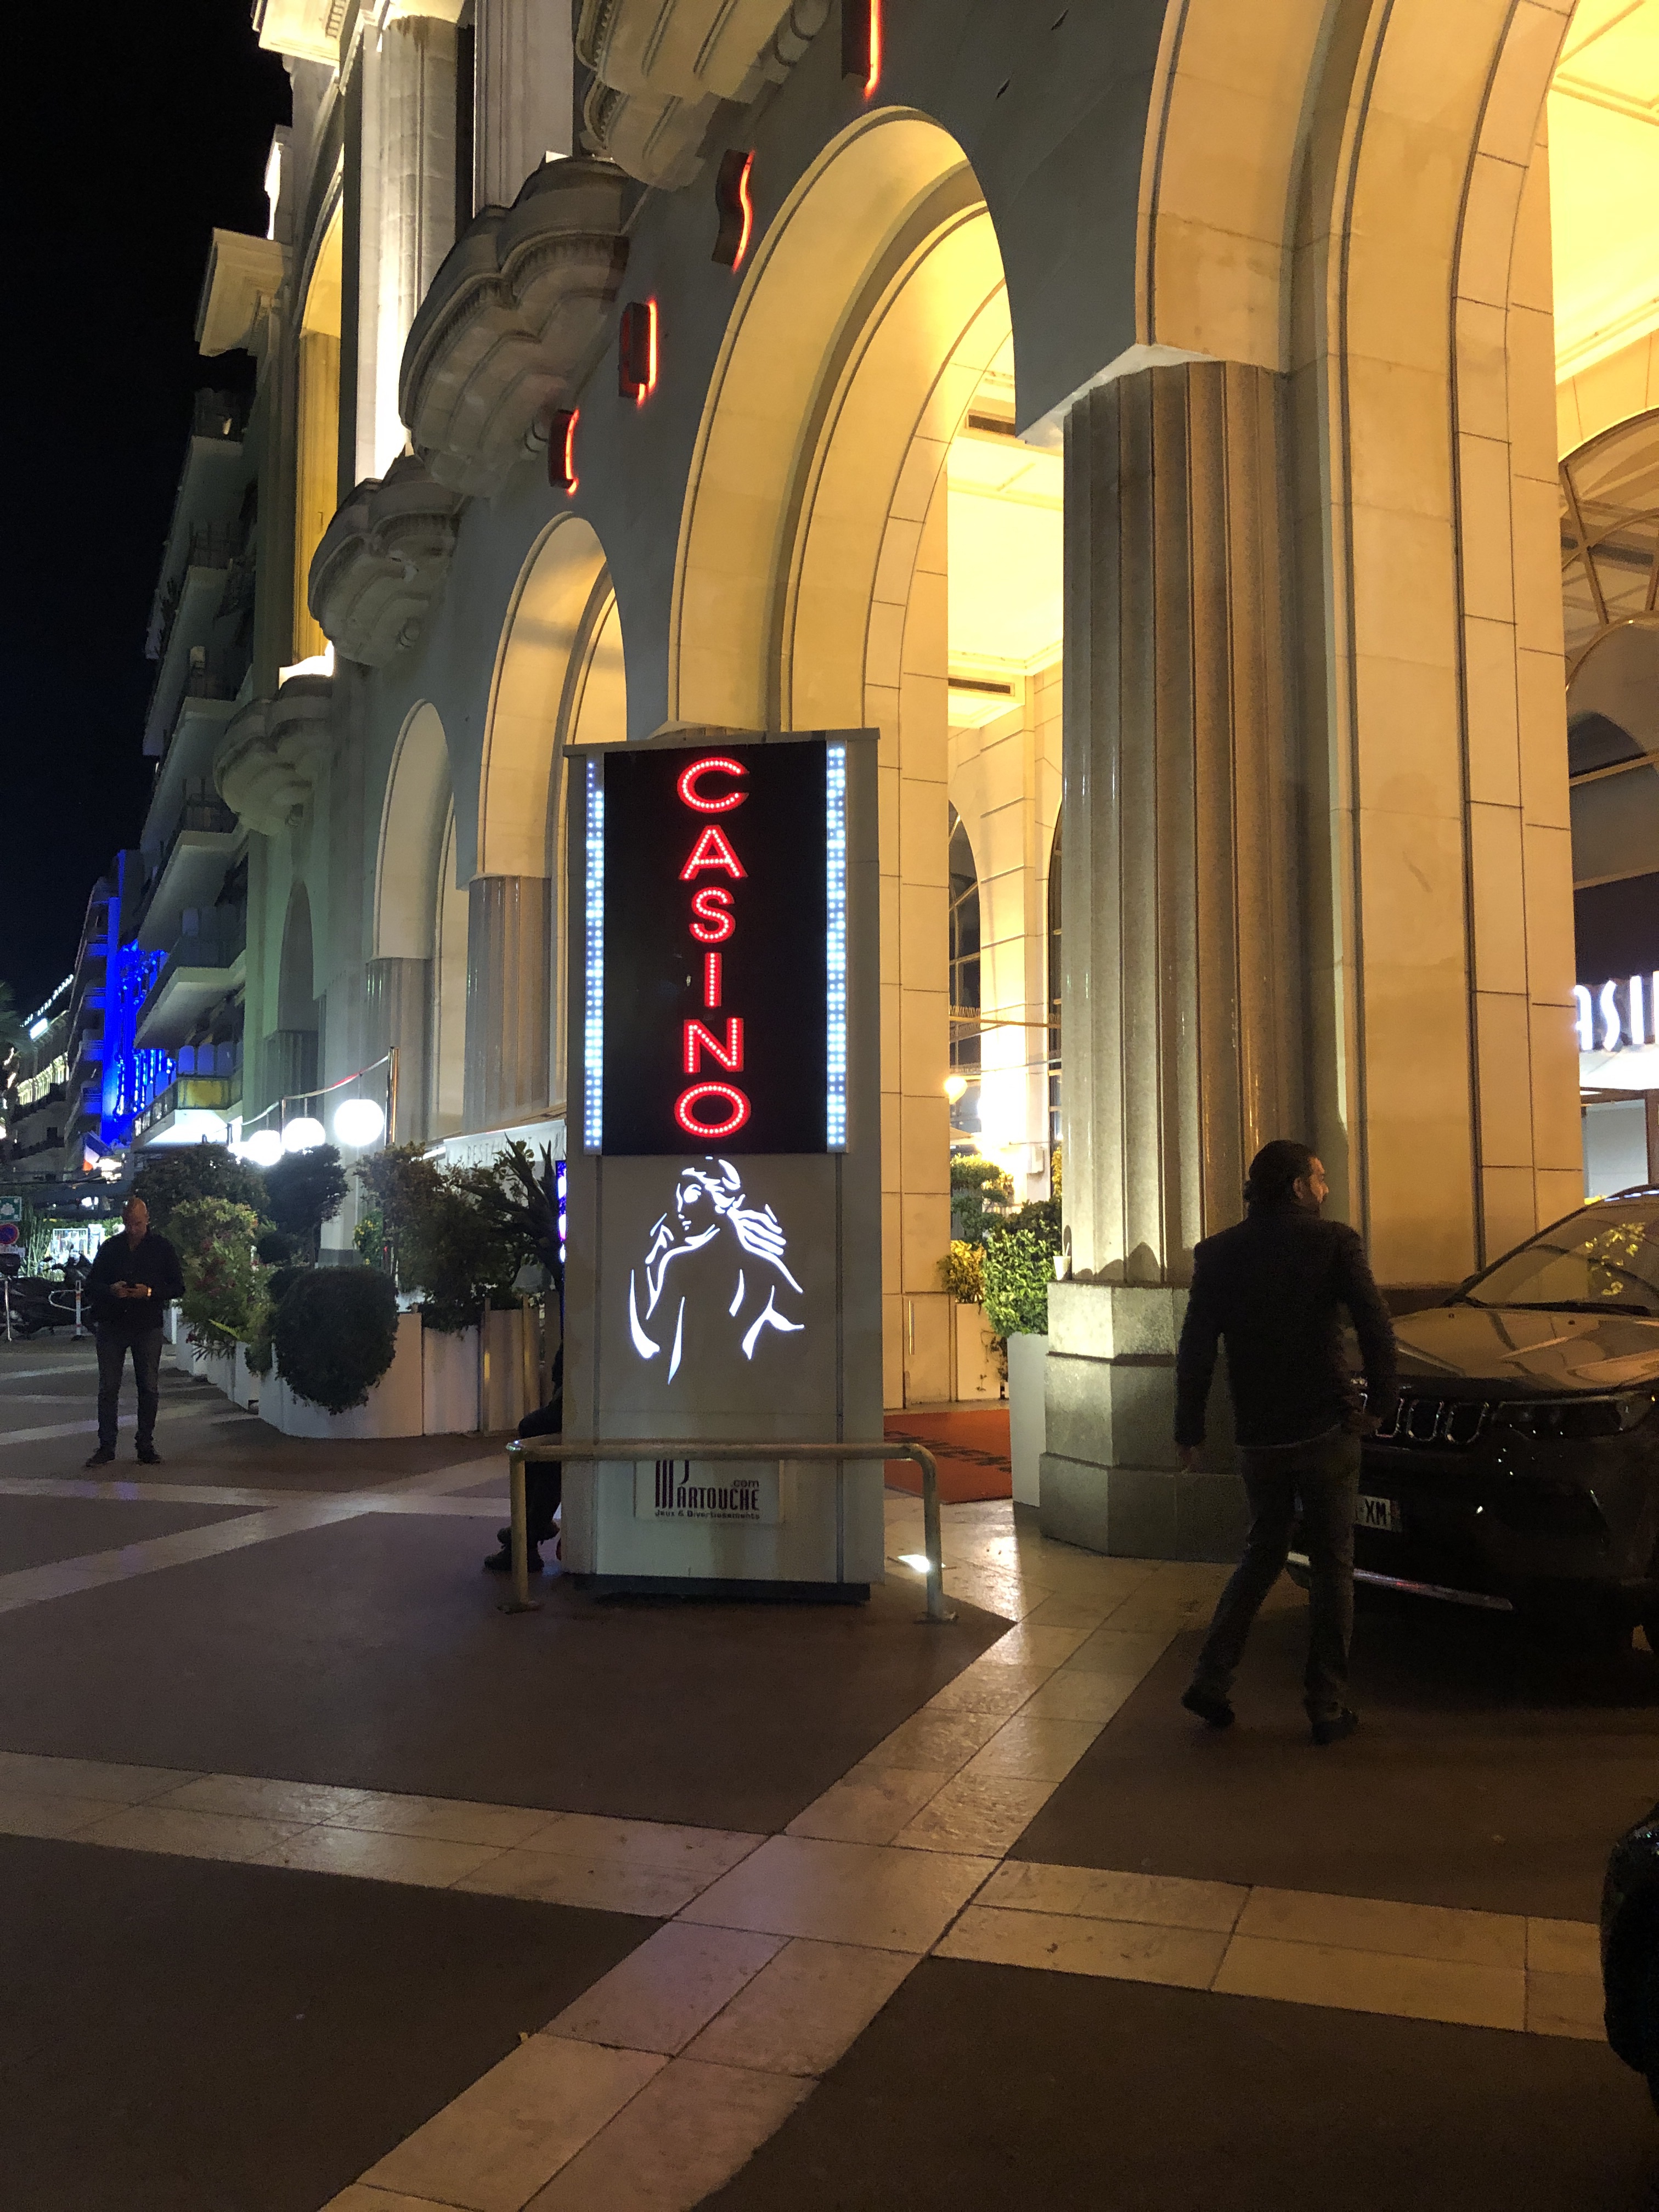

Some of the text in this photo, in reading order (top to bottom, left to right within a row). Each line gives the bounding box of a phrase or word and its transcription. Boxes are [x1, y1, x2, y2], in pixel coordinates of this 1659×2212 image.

[674, 757, 751, 1138] CASINO
[656, 1509, 675, 1517] Jeux
[687, 1510, 760, 1519] Divertissements
